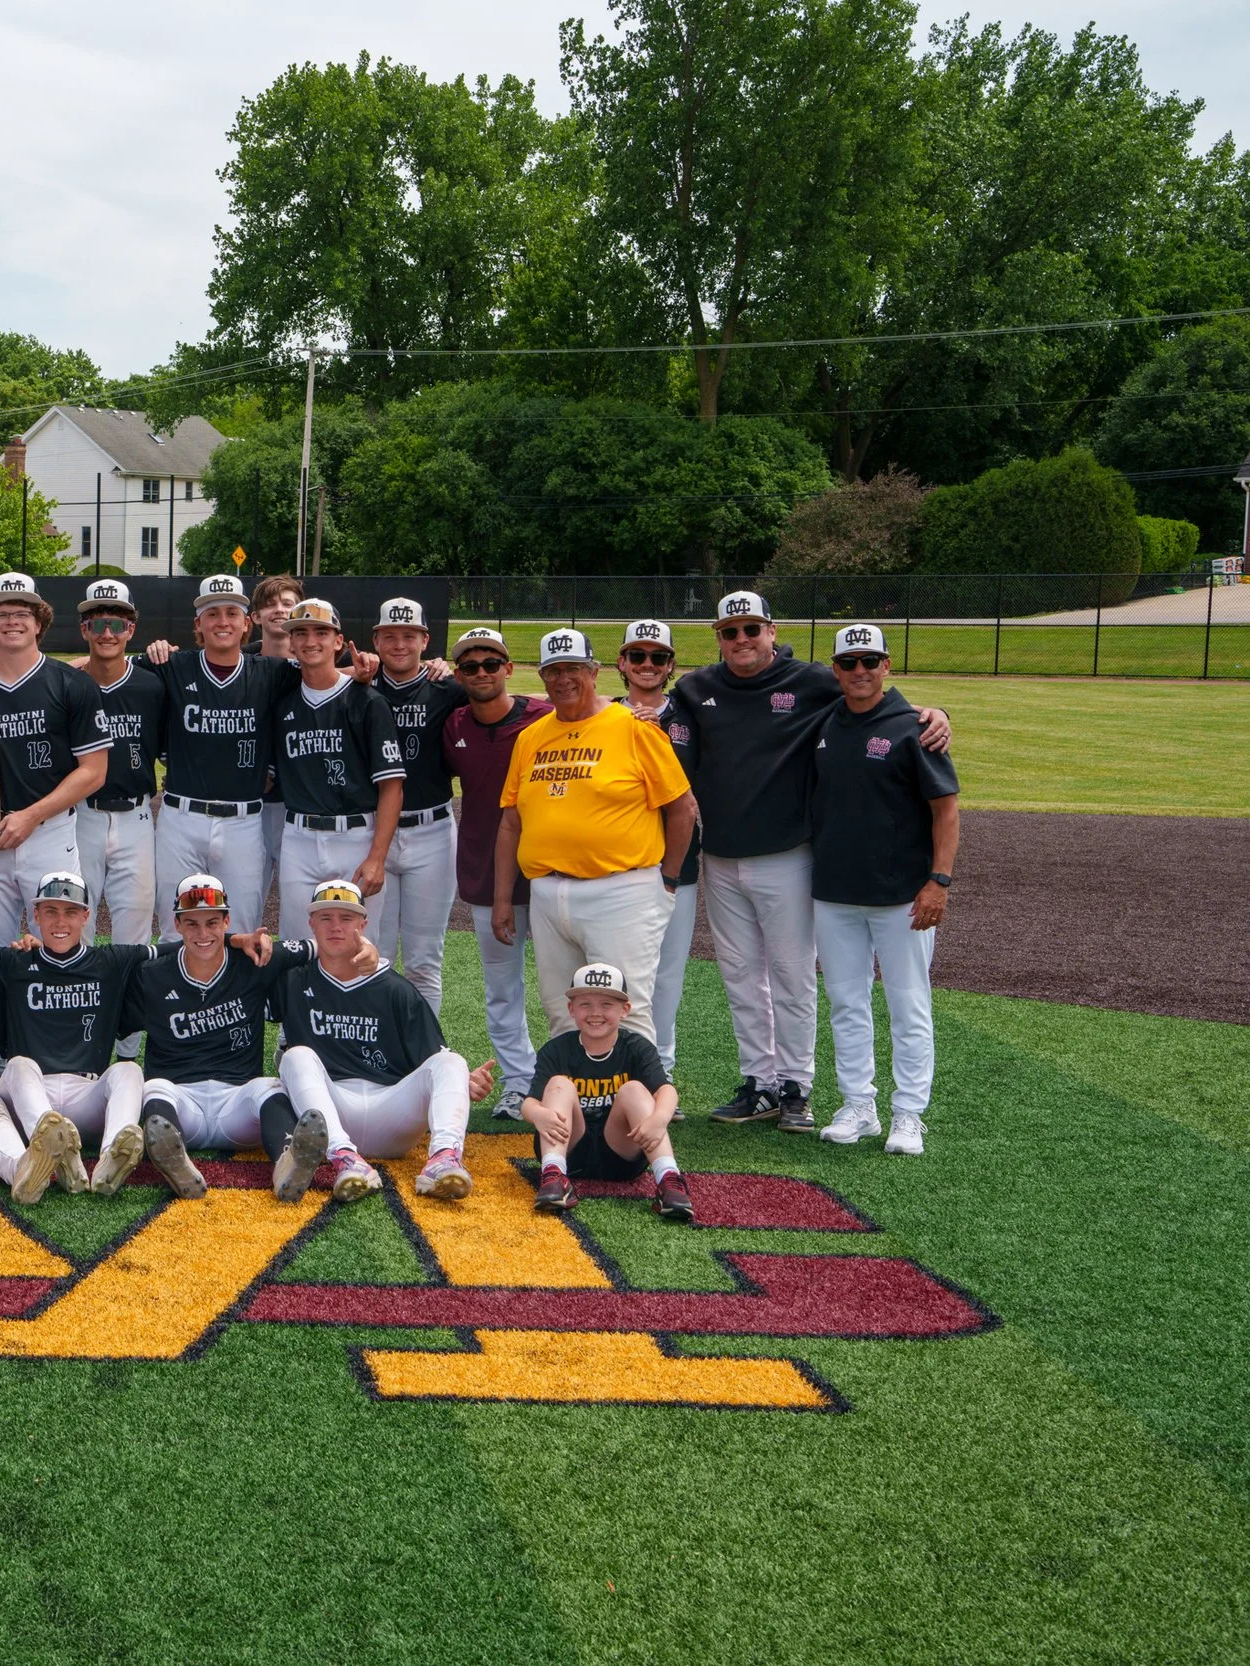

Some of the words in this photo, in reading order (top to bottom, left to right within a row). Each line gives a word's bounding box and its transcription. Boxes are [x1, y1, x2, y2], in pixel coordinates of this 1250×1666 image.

[184, 704, 256, 734] CATHOLIC
[202, 708, 255, 719] MONTINI
[27, 741, 52, 769] 12
[131, 743, 141, 769] 5
[237, 739, 256, 768] 11
[405, 733, 420, 760] 9
[534, 748, 603, 765] MONTINI
[529, 767, 593, 783] BASEBALL
[27, 982, 101, 1011] CATHOLIC
[45, 982, 100, 994] MONTINI
[169, 1004, 247, 1039] CATHOLIC
[188, 998, 242, 1021] MONTINI
[325, 1014, 379, 1026] MONTINI
[82, 1014, 96, 1042] 7
[565, 1072, 629, 1097] ONTINI
